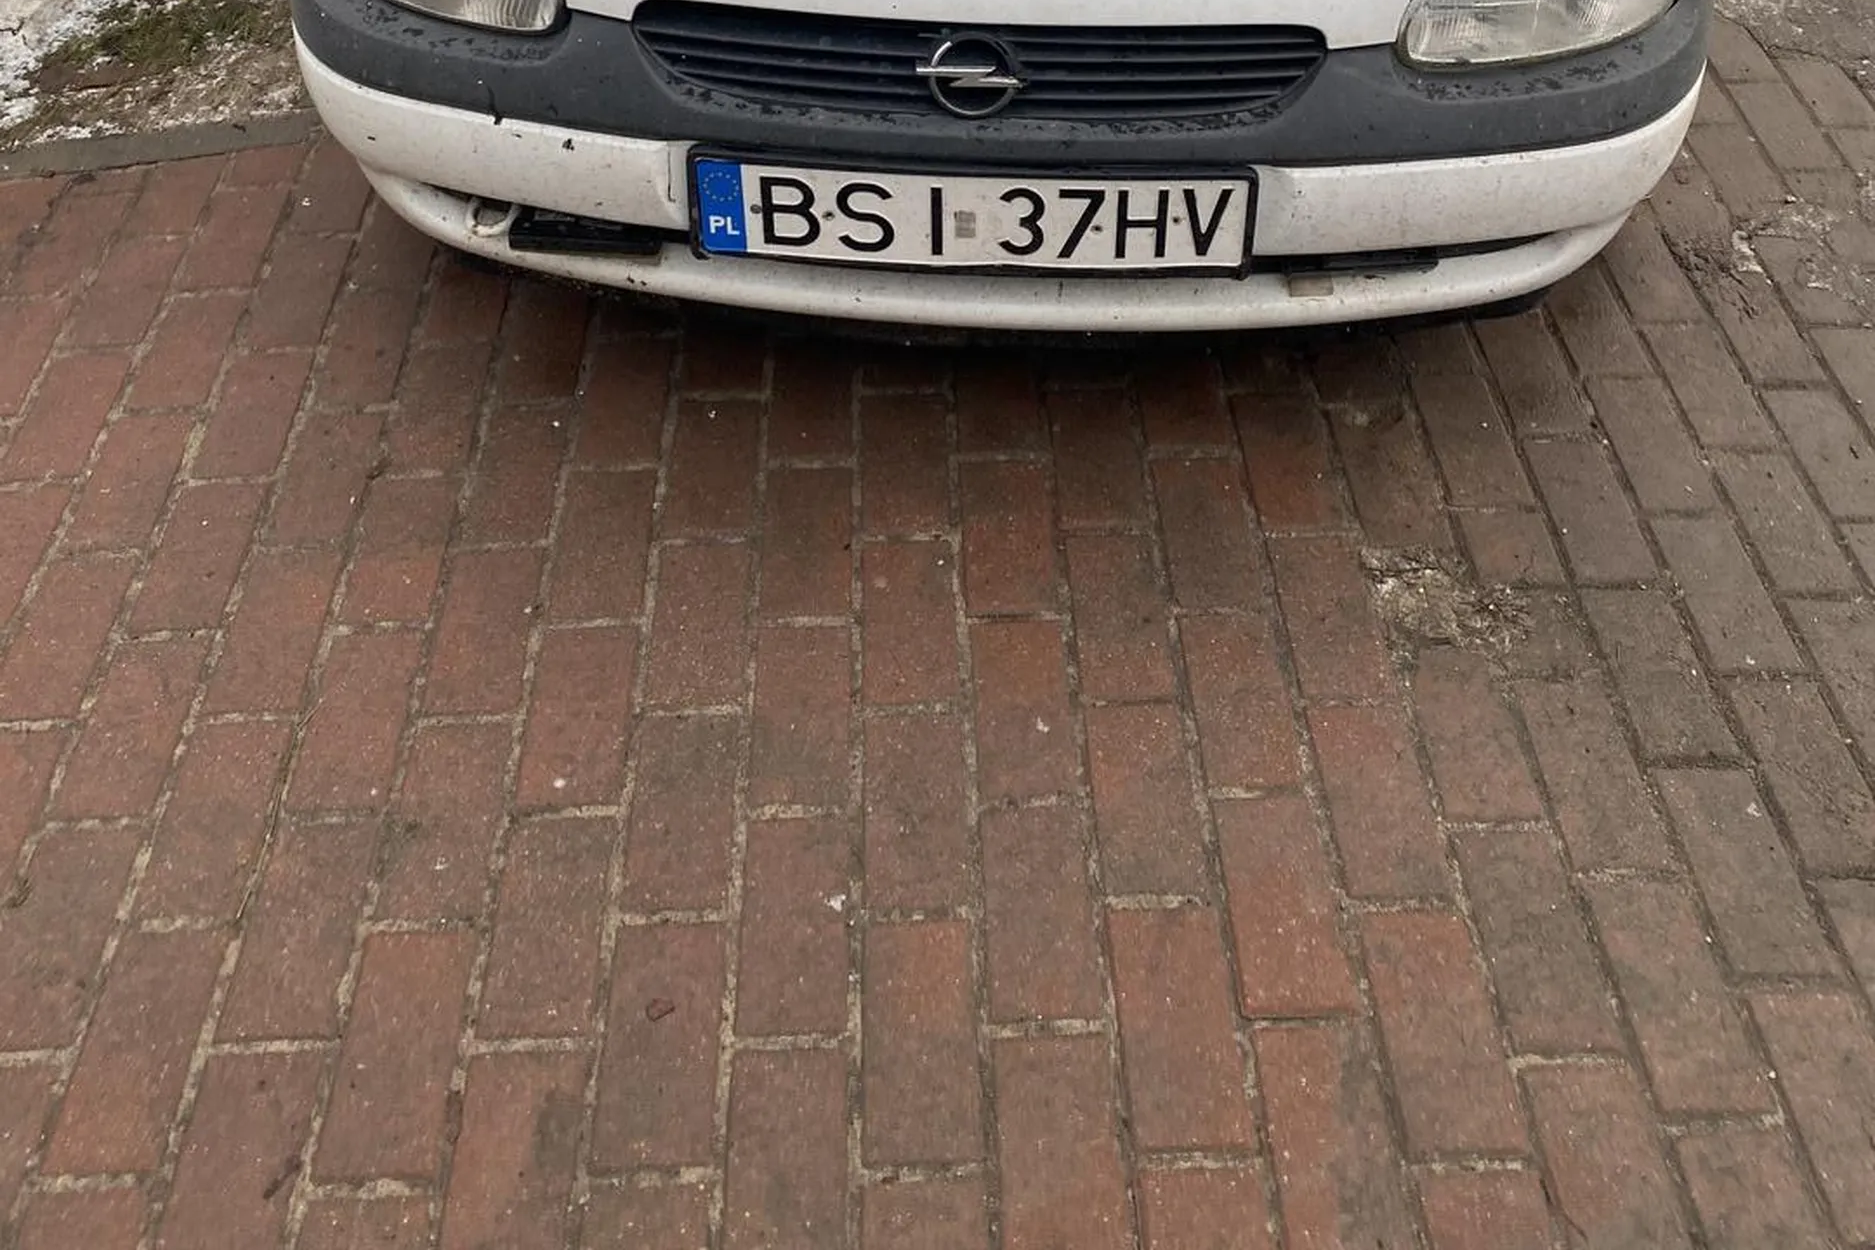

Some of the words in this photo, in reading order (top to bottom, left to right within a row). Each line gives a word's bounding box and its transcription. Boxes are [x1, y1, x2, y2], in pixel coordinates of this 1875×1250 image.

[708, 215, 740, 236] PL
[759, 175, 944, 256] BSI
[997, 187, 1235, 259] 37HV
